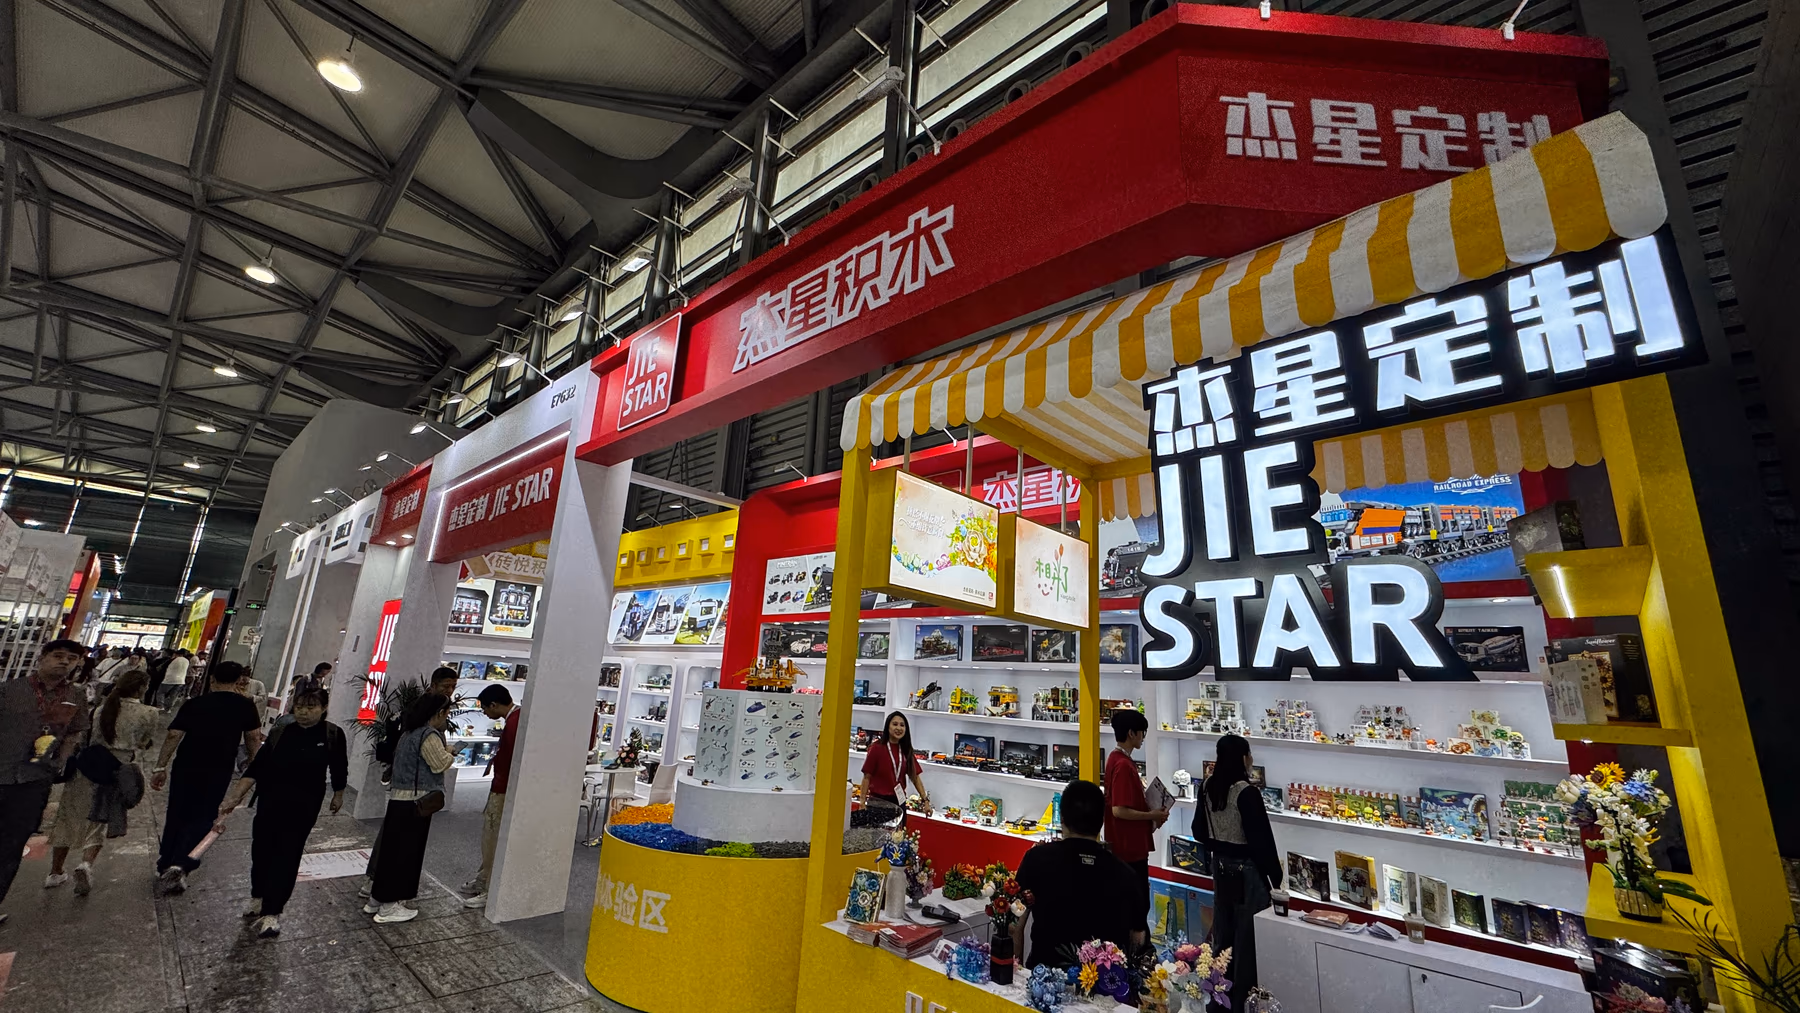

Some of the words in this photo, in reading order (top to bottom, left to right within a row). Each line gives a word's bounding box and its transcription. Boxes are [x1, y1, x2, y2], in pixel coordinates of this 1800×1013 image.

[732, 204, 955, 374] 杰星积木
[628, 336, 660, 386] JIE
[1148, 235, 1684, 456] 杰星定制
[622, 371, 668, 418] STAR
[448, 492, 489, 532] 杰星定制
[489, 484, 511, 521] JIE
[512, 467, 553, 511] STAR
[1141, 441, 1309, 577] JIE
[1433, 481, 1472, 491] RAILROAD
[1474, 476, 1511, 487] EXPRESS
[1144, 564, 1444, 669] STAR
[1584, 638, 1616, 647] Sunflower
